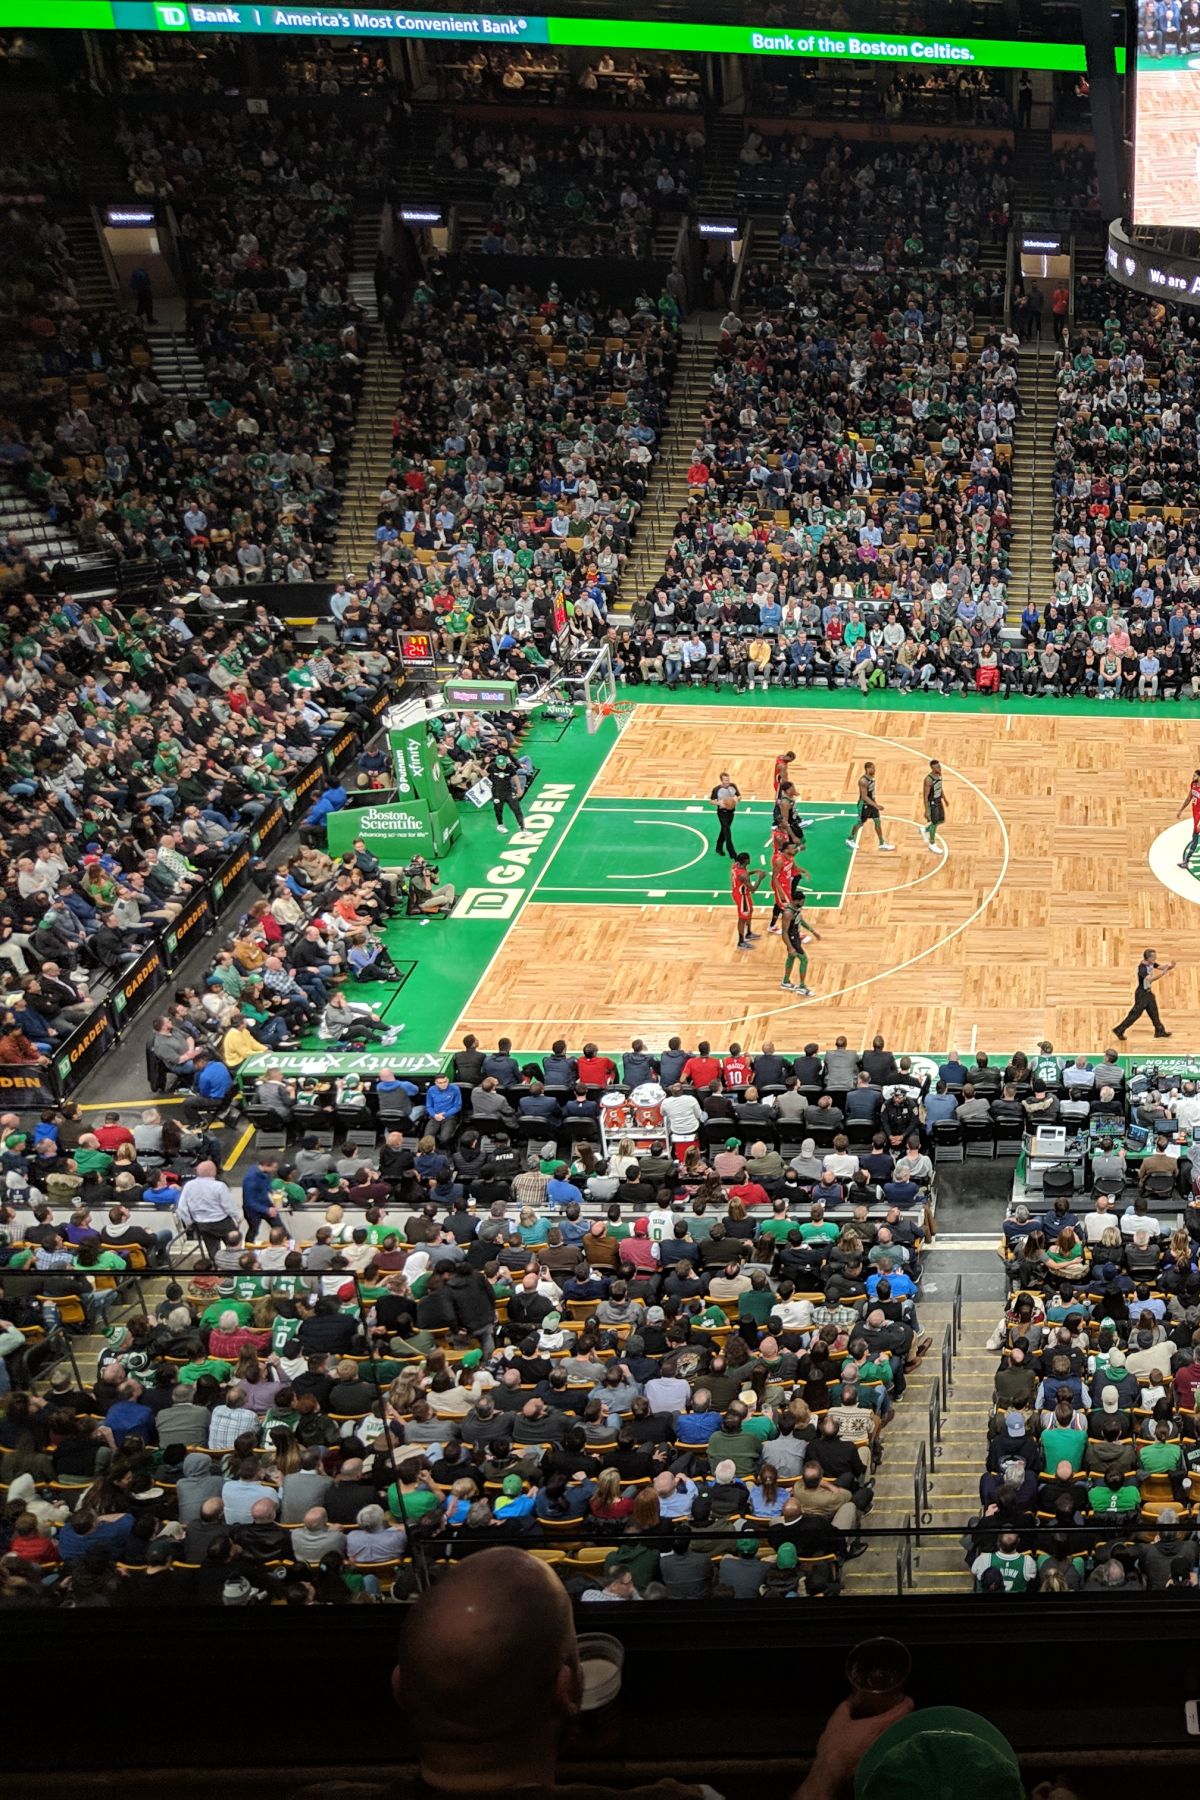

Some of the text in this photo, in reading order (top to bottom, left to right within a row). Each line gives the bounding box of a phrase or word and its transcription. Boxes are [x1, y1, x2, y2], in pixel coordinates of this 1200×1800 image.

[161, 8, 186, 27] TD
[192, 8, 241, 25] Bank
[275, 10, 350, 28] America's
[353, 12, 393, 30] Most
[395, 15, 479, 33] Convenient
[752, 33, 975, 60] Bank of the Boston Celtics.
[1150, 268, 1166, 285] We
[1169, 274, 1187, 289] are
[409, 645, 425, 656] 24
[407, 739, 424, 776] xfinity
[361, 816, 423, 830] Scientific
[369, 808, 408, 820] Boston
[464, 783, 576, 916] TD GARDEN
[222, 852, 250, 888] GARDEN
[176, 901, 208, 940] GARDEN
[125, 955, 160, 998] GARDEN
[70, 1016, 109, 1063] GARDEN
[349, 1053, 445, 1071] xfinity
[729, 1071, 742, 1084] 10
[1038, 1067, 1057, 1082] 42
[654, 1228, 663, 1241] 0
[276, 1332, 287, 1348] 0
